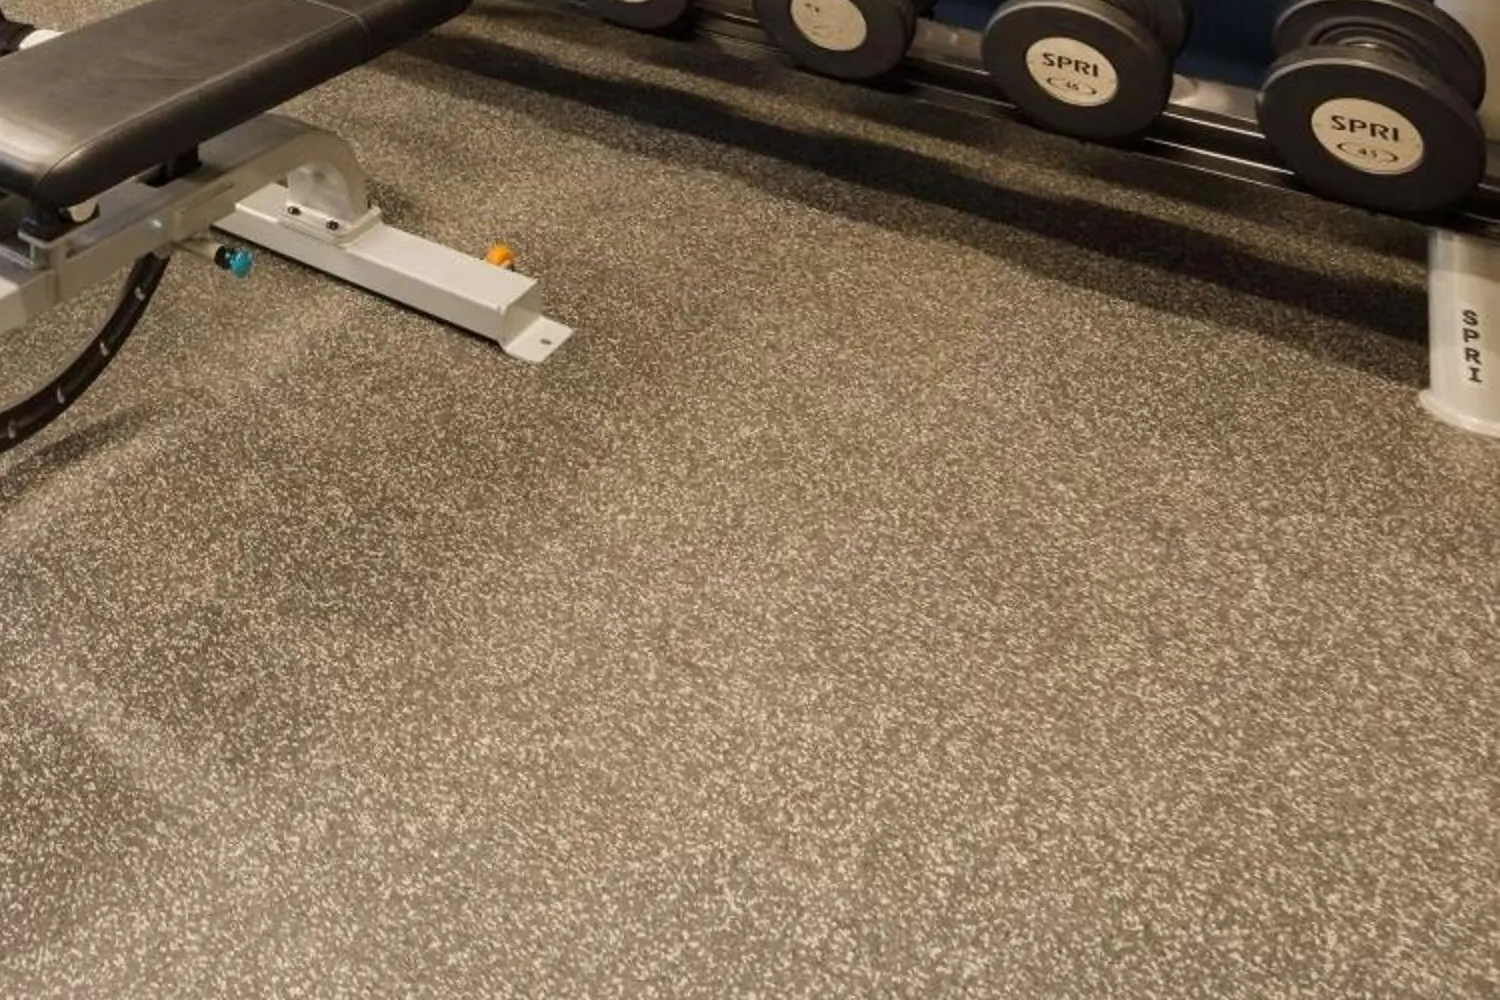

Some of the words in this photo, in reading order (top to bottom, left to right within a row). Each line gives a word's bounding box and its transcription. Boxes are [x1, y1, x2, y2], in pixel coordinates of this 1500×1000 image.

[1042, 52, 1099, 78] SPRI
[1331, 114, 1400, 143] SPRI
[1462, 309, 1483, 384] SPRI
